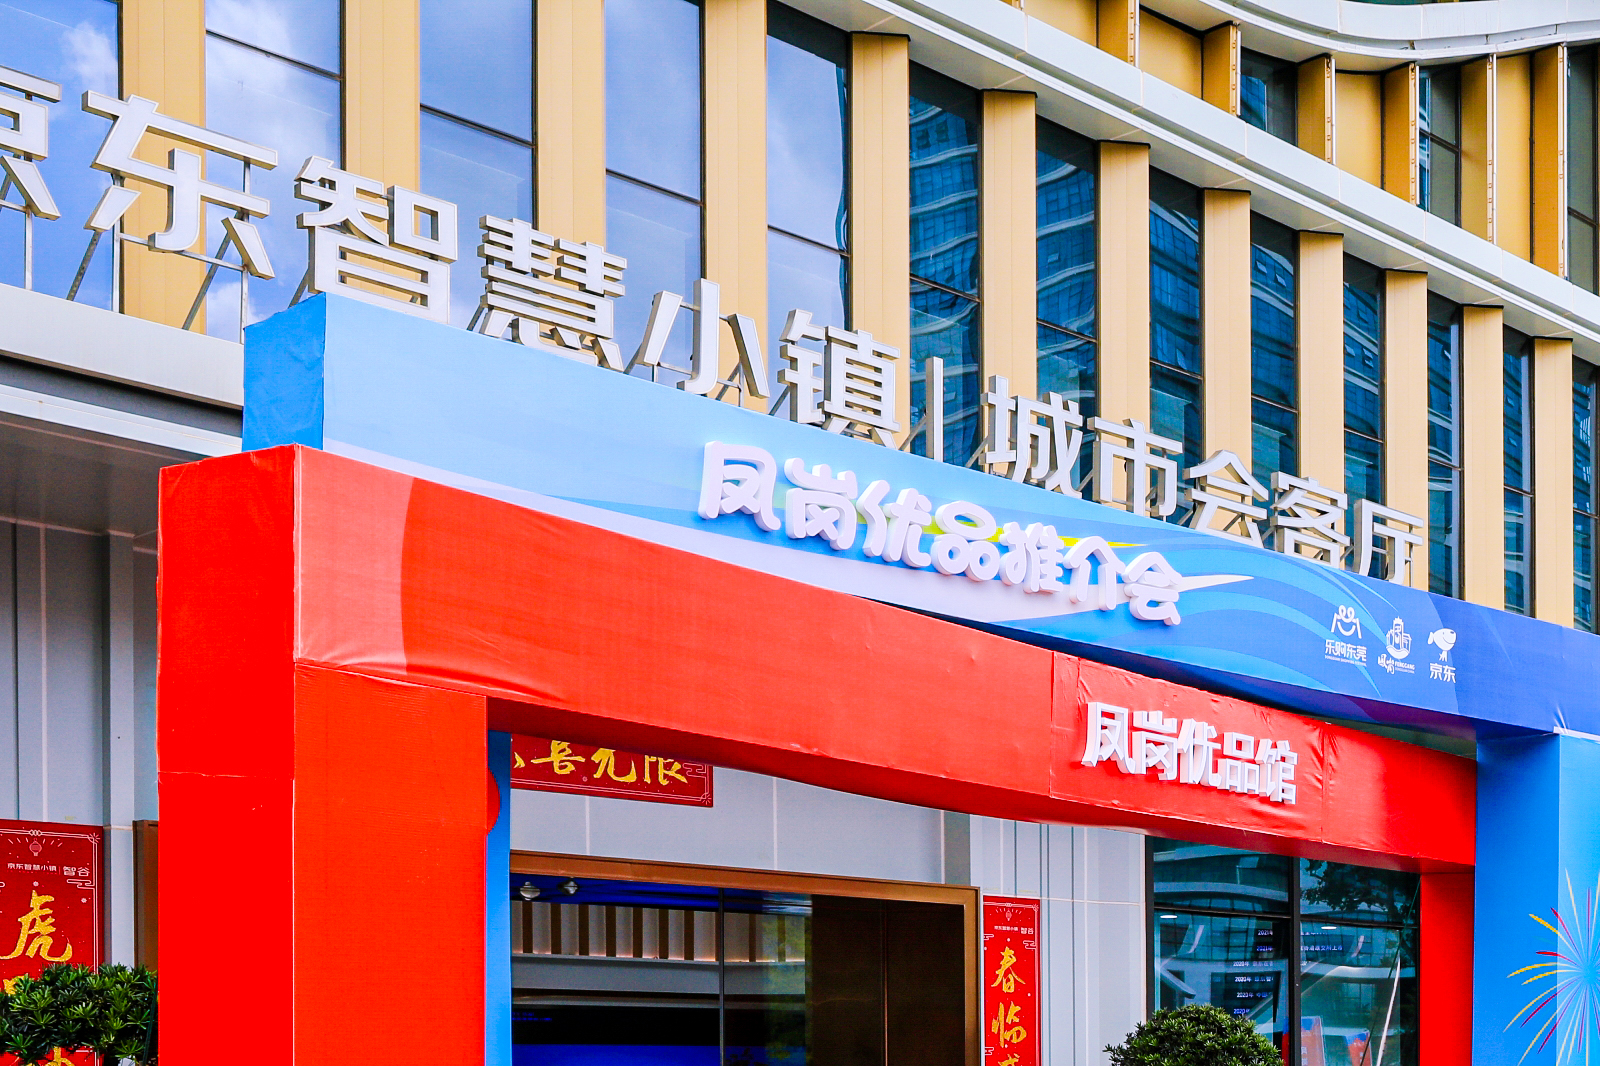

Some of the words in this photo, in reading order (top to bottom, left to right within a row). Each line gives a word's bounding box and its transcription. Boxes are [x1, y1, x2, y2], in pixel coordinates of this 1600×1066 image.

[980, 374, 1424, 584] 城市会客厅
[697, 440, 1183, 627] 凤岗优品推介会
[1324, 639, 1367, 662] 乐购东莞
[1429, 662, 1457, 684] 京东
[513, 739, 688, 786] 喜无限
[1081, 701, 1298, 804] 凤岗优品馆
